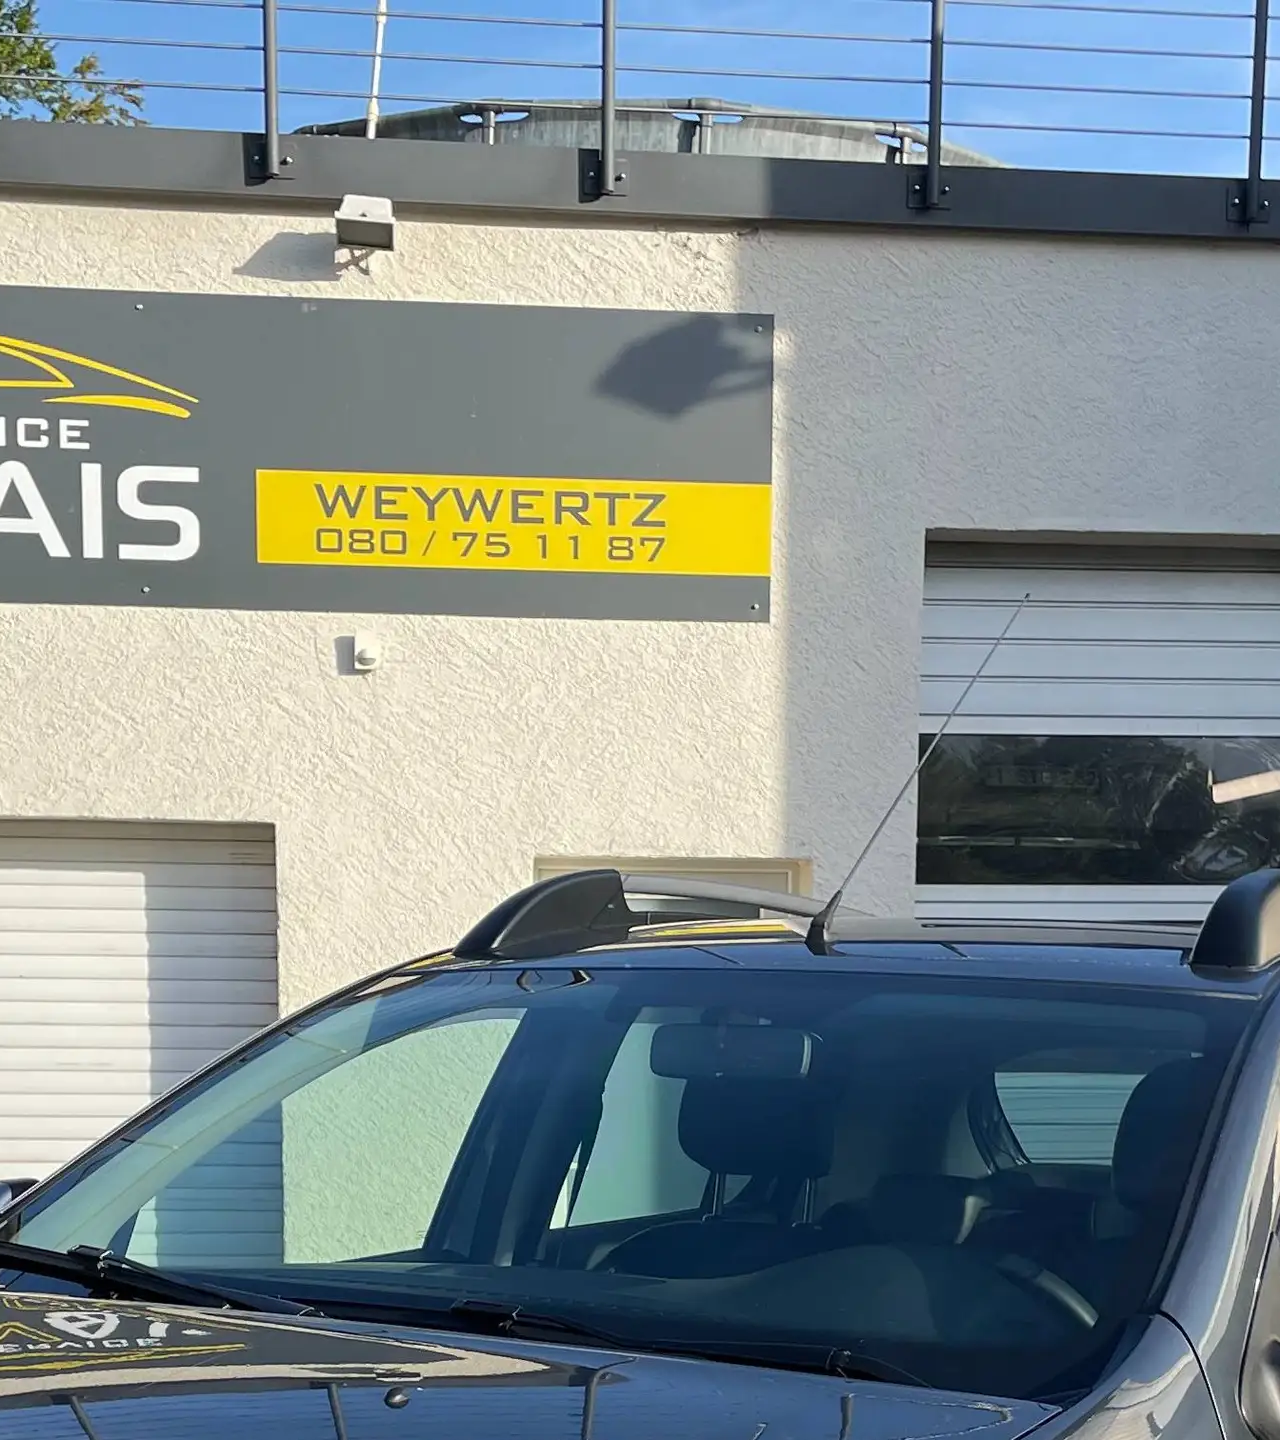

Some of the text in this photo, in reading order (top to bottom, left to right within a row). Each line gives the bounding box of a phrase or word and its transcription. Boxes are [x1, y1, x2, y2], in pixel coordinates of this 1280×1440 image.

[314, 483, 667, 528] WEYWERTZ
[535, 534, 581, 561] 11
[607, 536, 666, 562] 87
